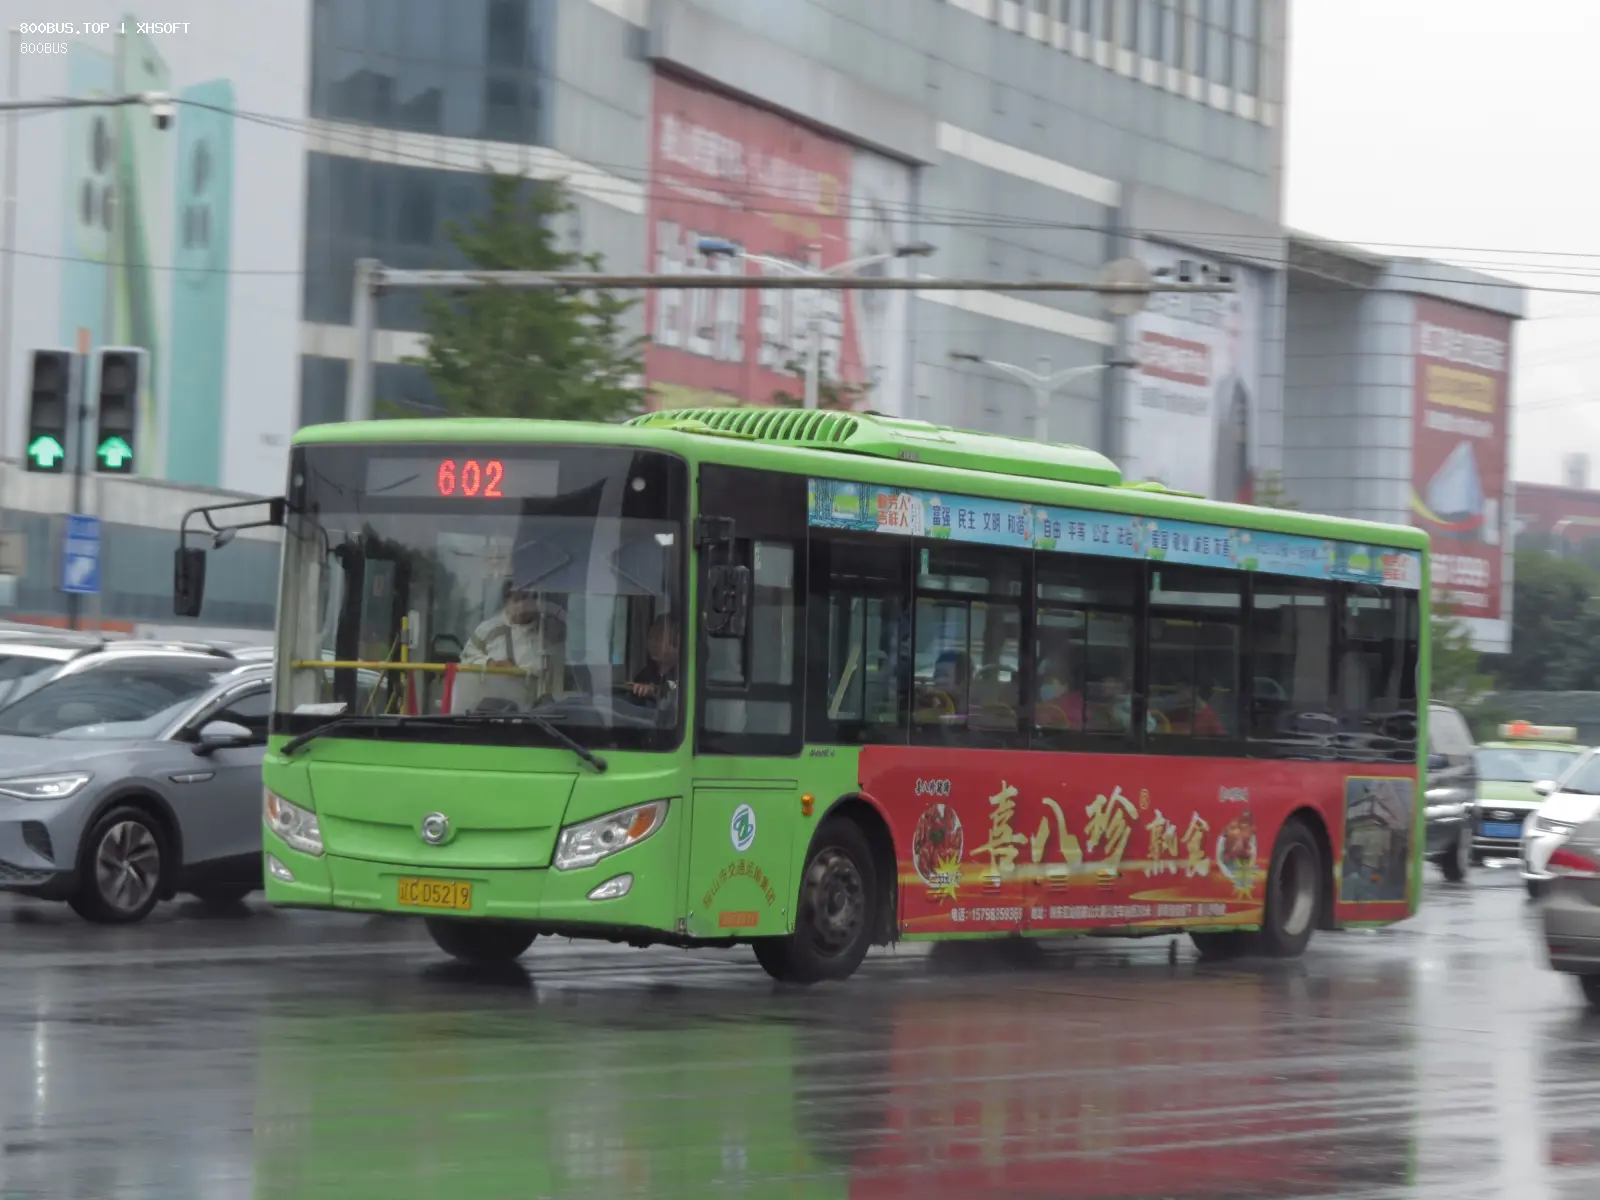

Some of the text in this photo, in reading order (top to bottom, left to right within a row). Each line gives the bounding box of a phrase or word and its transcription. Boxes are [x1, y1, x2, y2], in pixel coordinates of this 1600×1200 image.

[437, 460, 504, 497] 602
[932, 505, 951, 527] 富强
[958, 508, 977, 530] 民主
[983, 511, 1001, 533] 文明
[1007, 513, 1025, 535] 和谐
[1043, 518, 1061, 539] 自由
[970, 779, 1139, 887] 喜八珍
